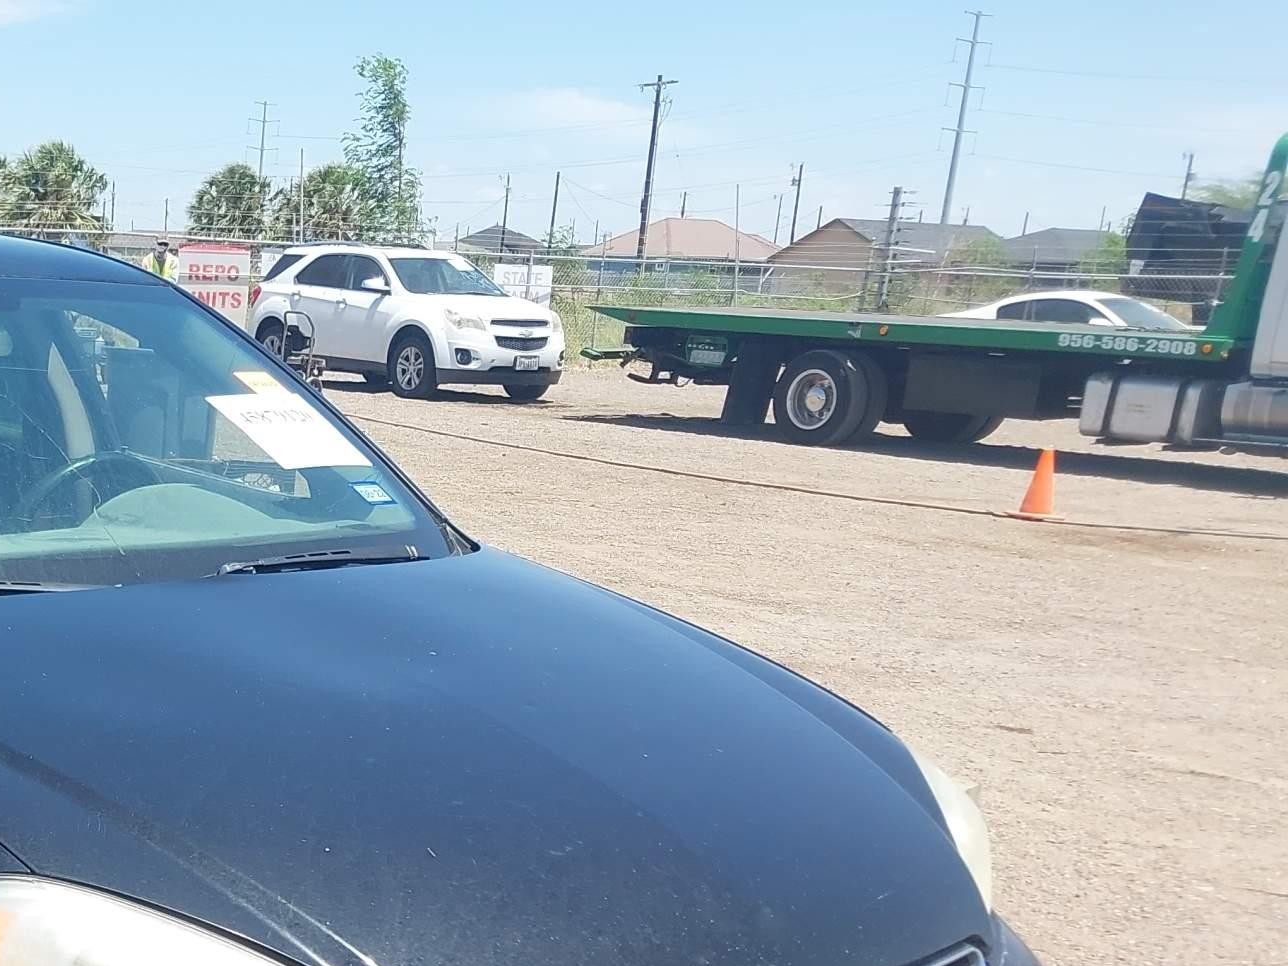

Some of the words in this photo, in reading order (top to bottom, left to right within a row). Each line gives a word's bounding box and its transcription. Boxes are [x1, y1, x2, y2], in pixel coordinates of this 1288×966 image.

[188, 264, 240, 282] REPO
[192, 291, 242, 309] NITS
[1057, 334, 1197, 355] 956-586-2908
